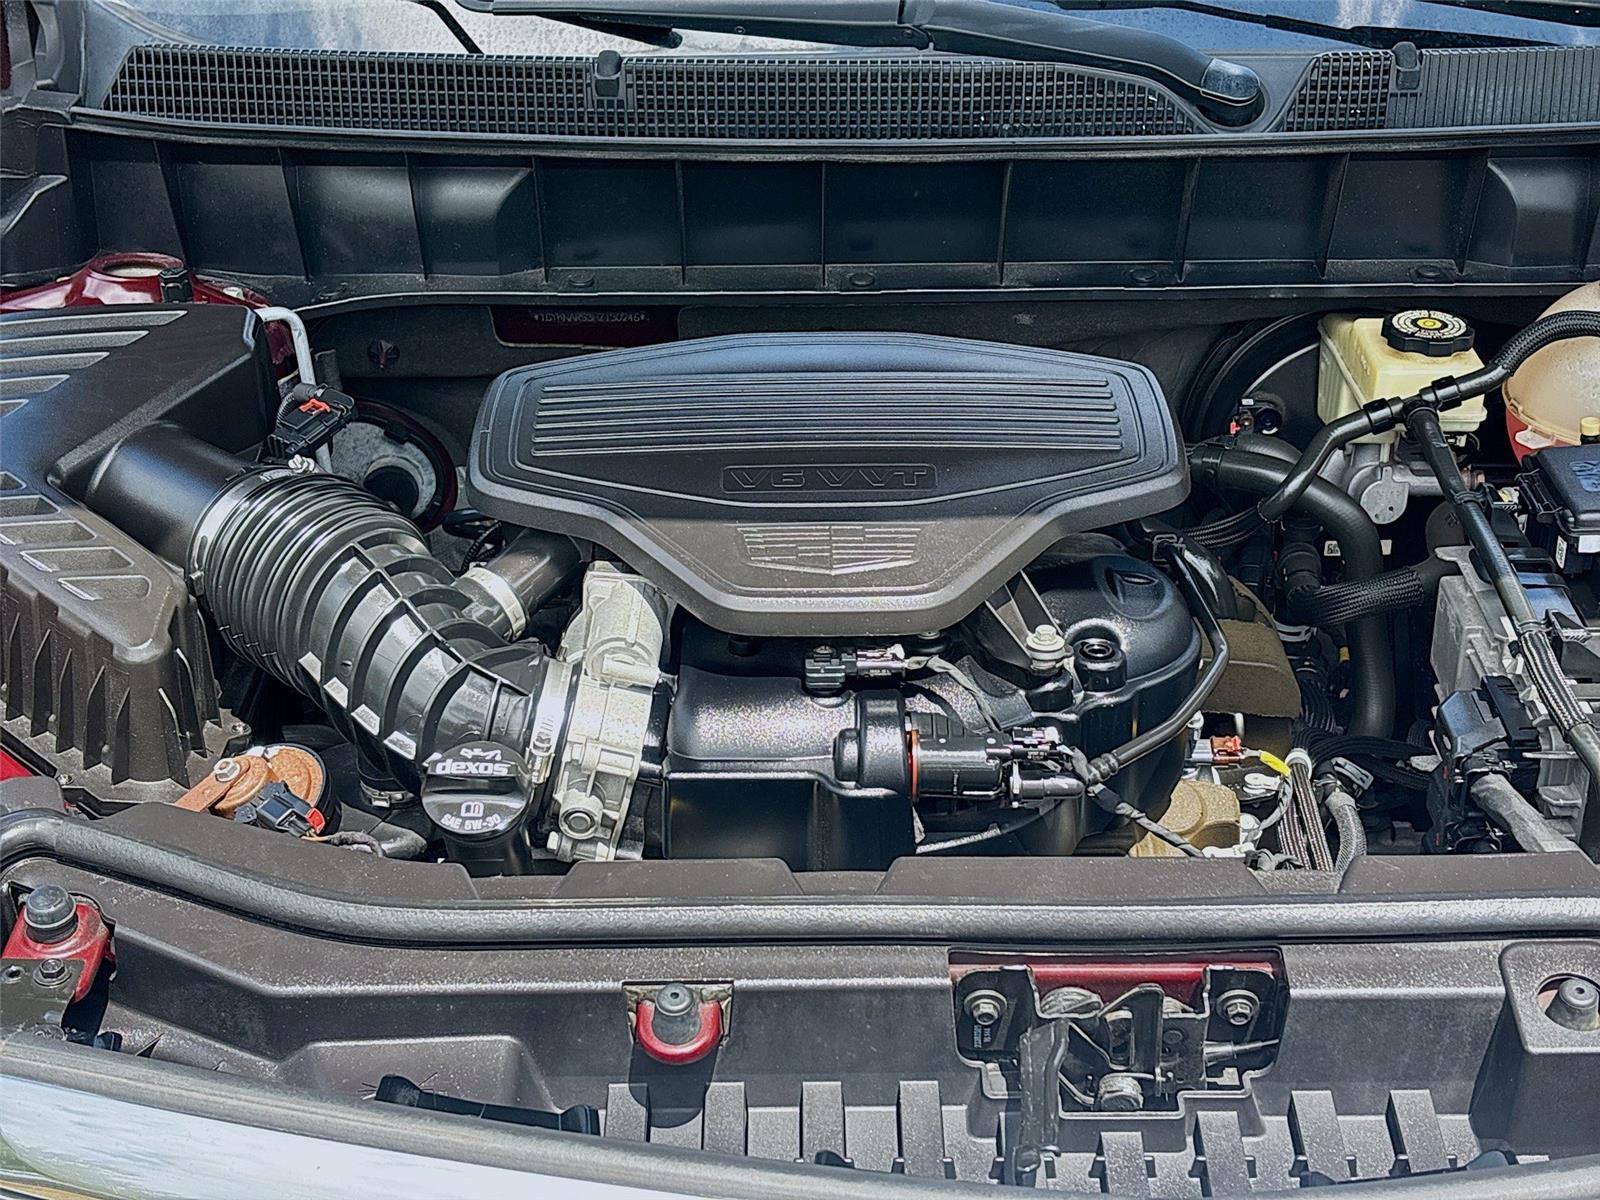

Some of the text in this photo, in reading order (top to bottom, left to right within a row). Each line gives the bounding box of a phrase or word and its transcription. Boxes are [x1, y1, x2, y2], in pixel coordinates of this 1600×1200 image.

[730, 468, 928, 488] V6 VVT
[435, 758, 509, 776] dexos
[440, 813, 463, 830] SAE
